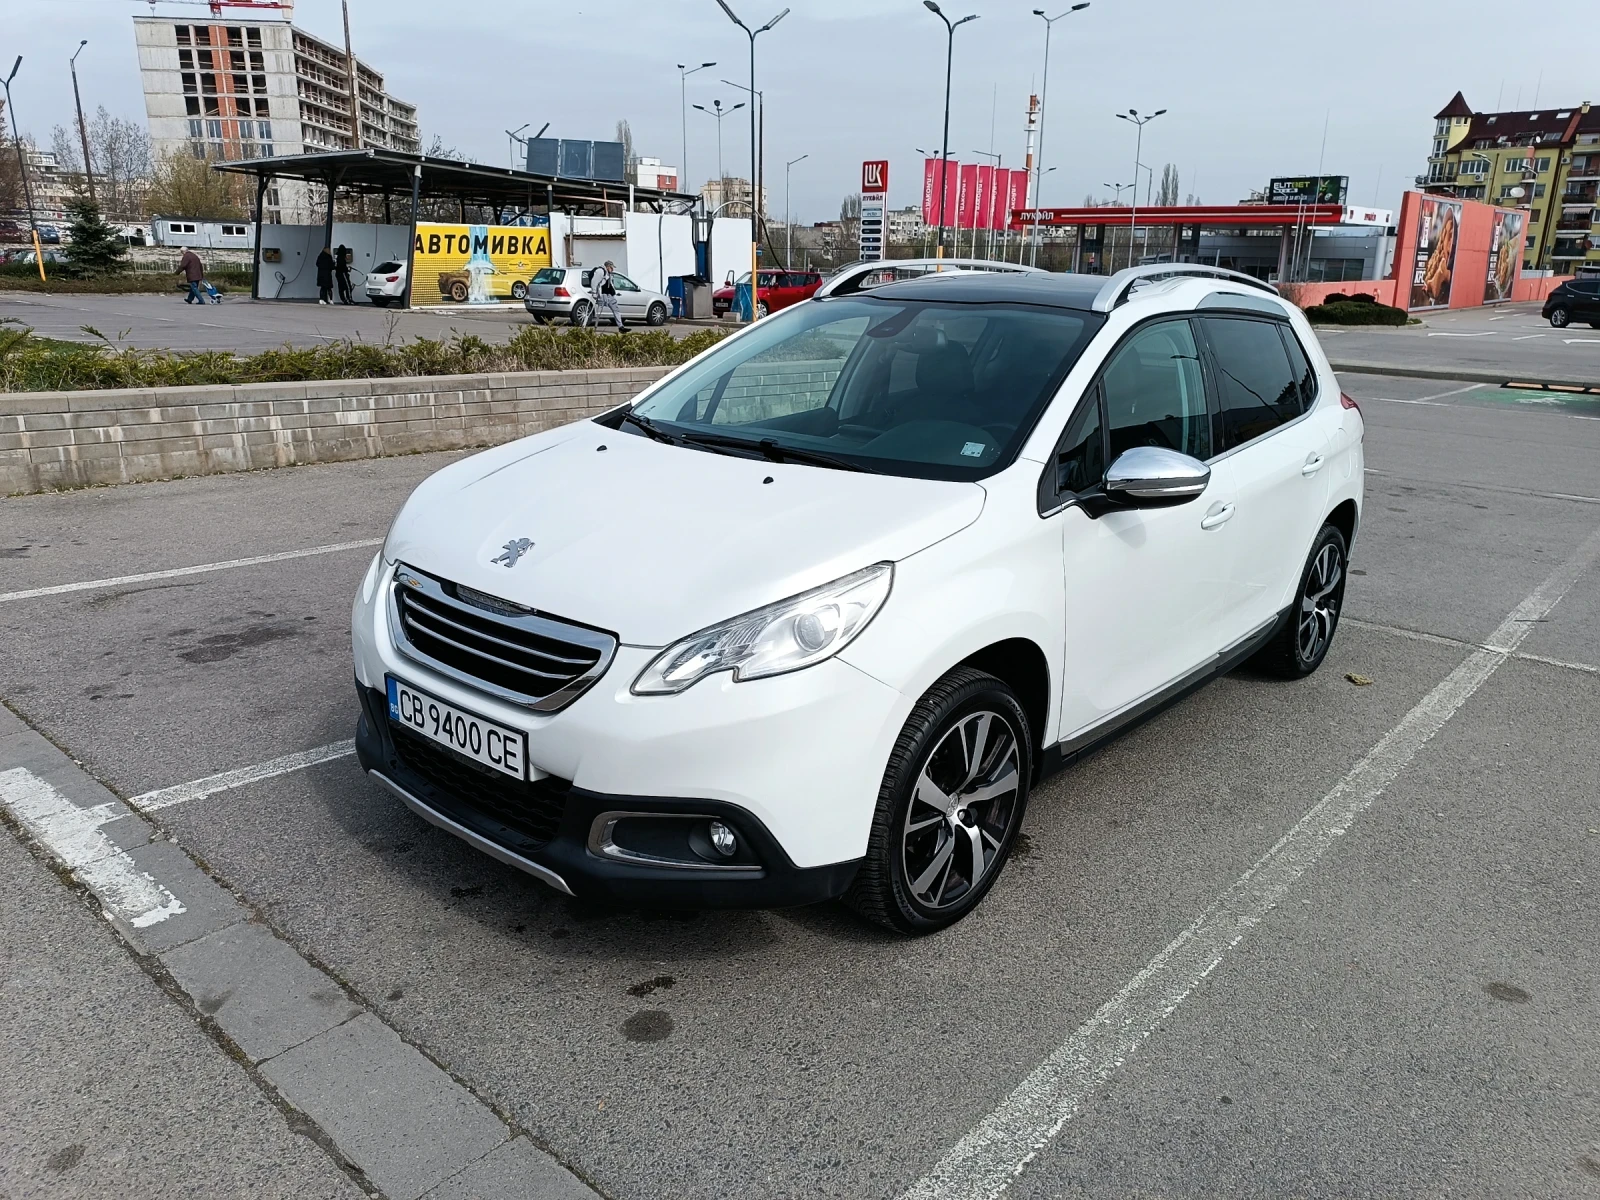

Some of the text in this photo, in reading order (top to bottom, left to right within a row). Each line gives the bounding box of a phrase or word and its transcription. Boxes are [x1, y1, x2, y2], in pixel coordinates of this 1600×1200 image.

[415, 233, 548, 255] АВТОМИВКА
[390, 703, 399, 714] BG
[400, 689, 519, 774] CB 9400 CE
